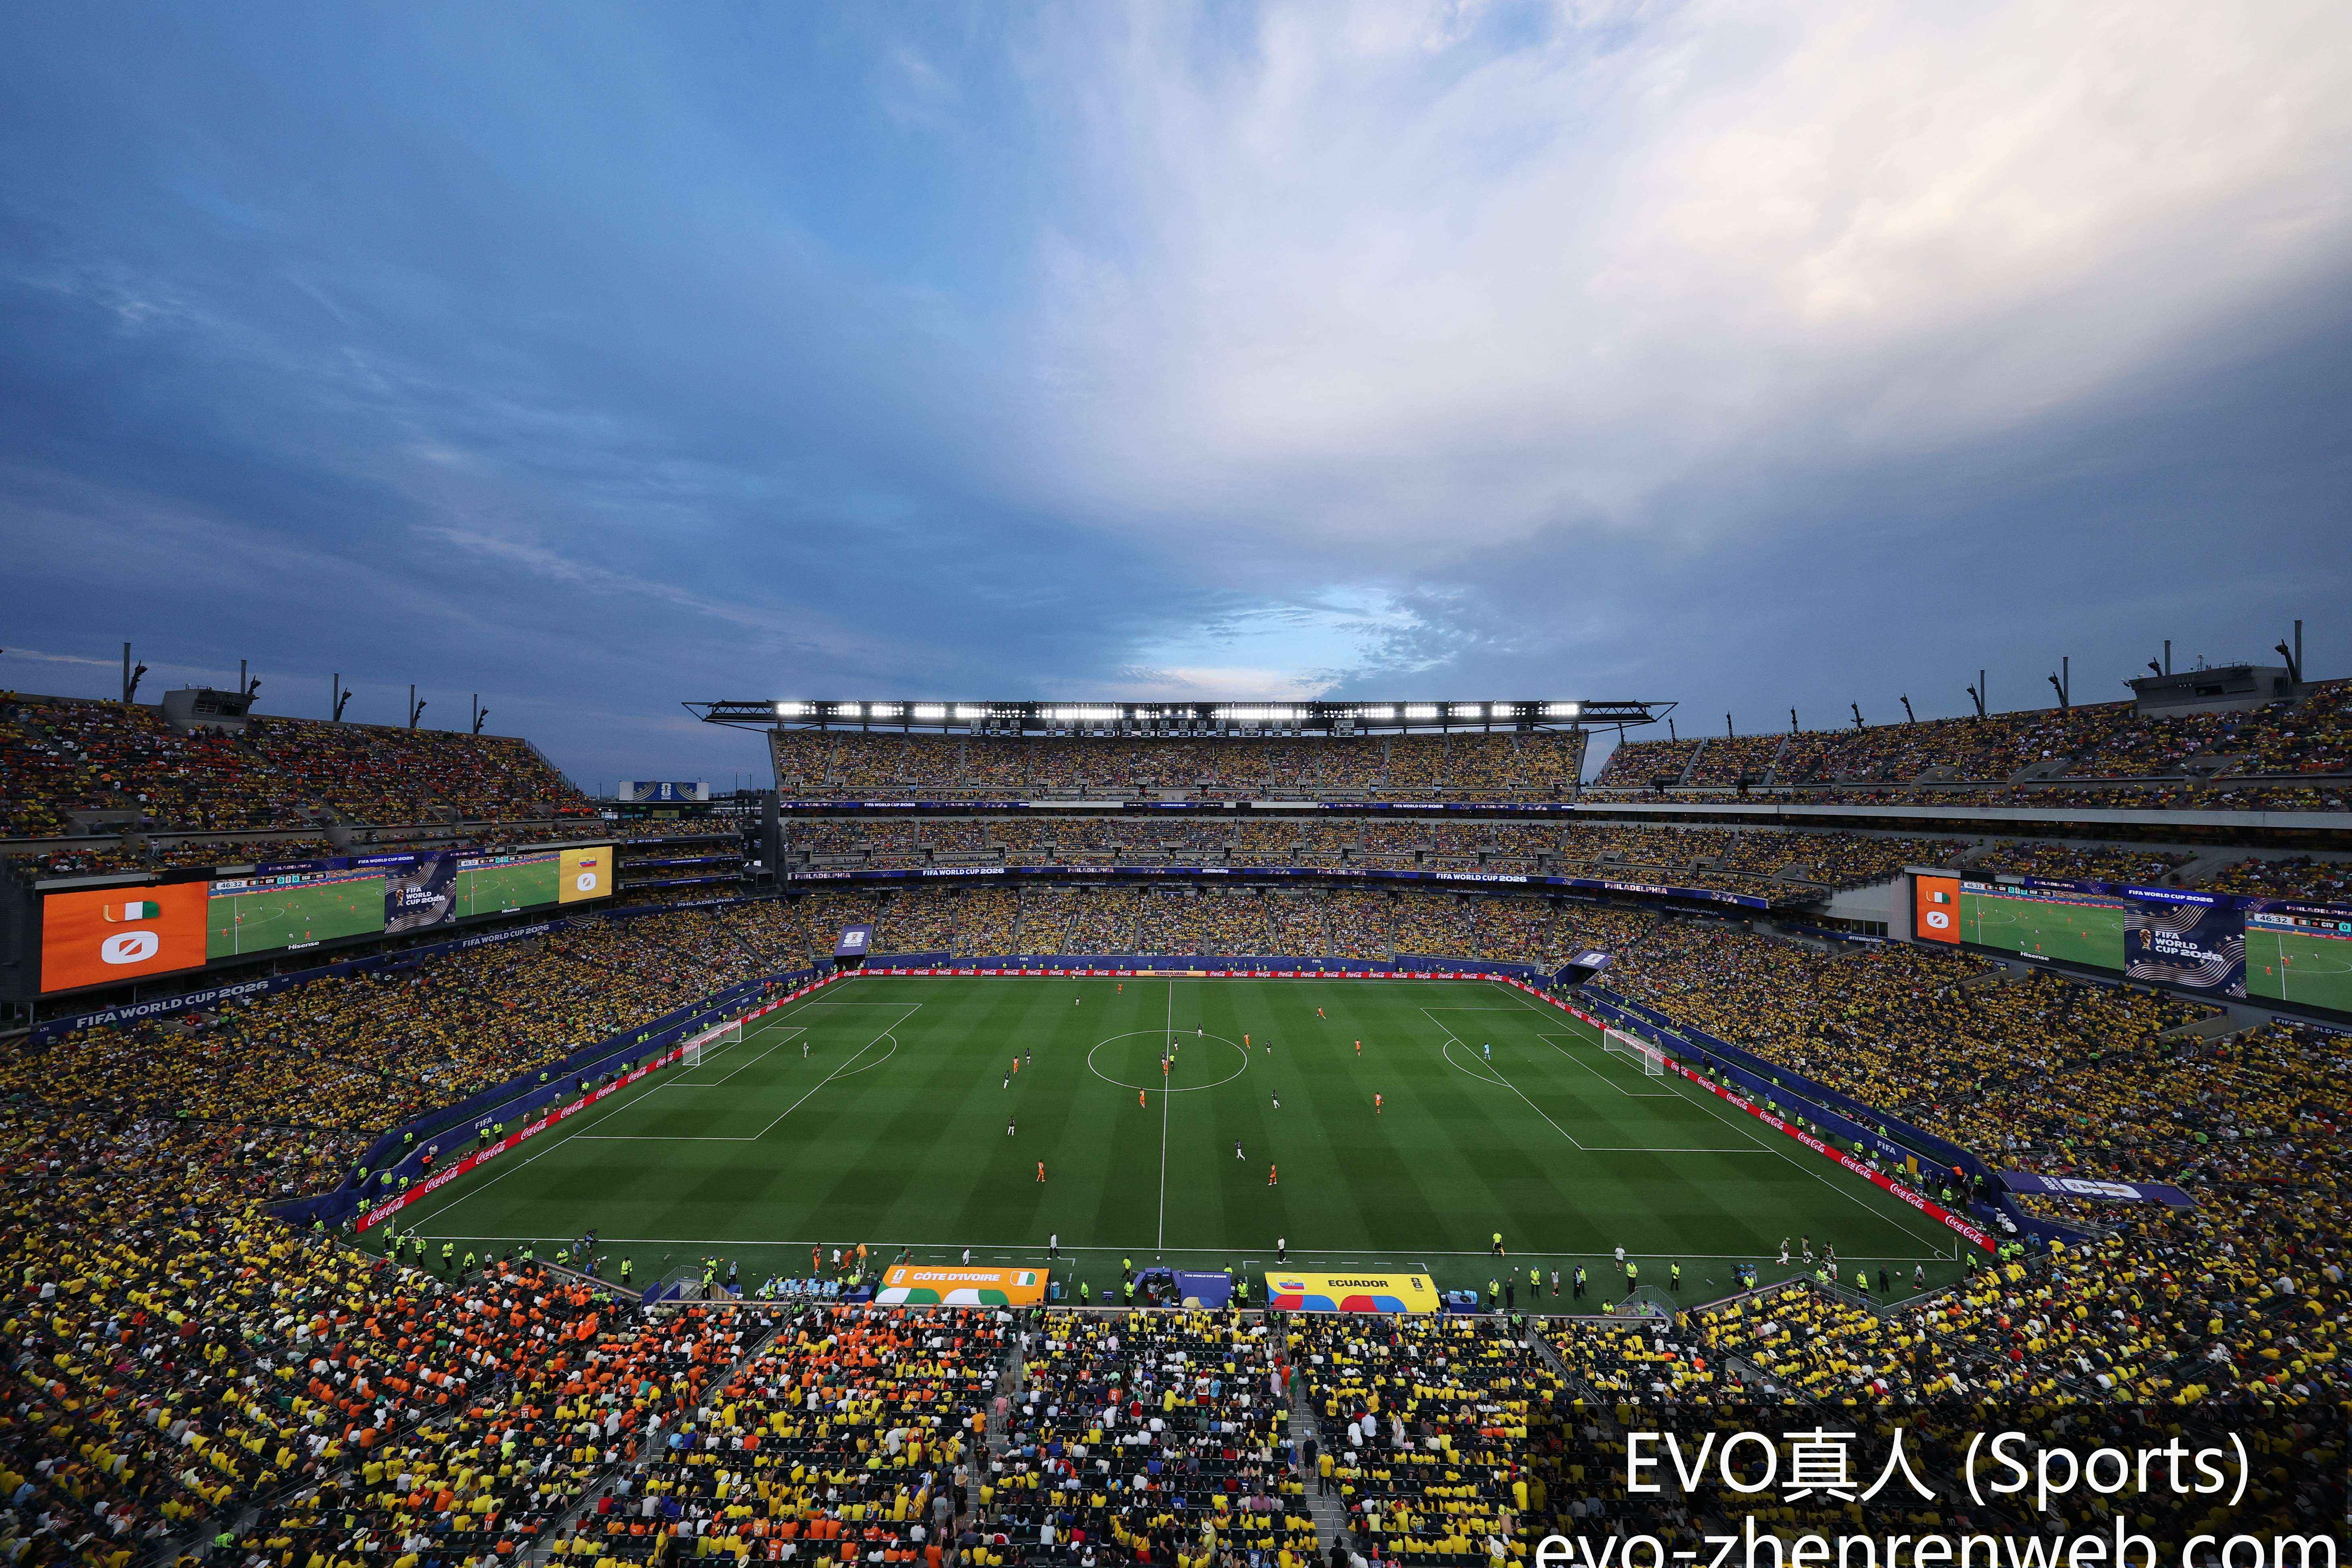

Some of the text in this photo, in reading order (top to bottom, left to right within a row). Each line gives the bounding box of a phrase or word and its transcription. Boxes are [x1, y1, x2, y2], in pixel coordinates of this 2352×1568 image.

[1604, 882, 1668, 894] PHILADELPHIA
[2034, 880, 2074, 888] PHILADELPHIA
[406, 891, 431, 899] WORLD
[421, 895, 445, 904] 2026
[677, 897, 734, 907] PHILADELPHIA
[1665, 906, 1719, 915] PHILADELPHIA
[2287, 905, 2352, 916] PHILADELPHIA
[2260, 915, 2287, 924] 46:32
[463, 939, 480, 947] FIFA
[482, 933, 509, 943] WORLD
[510, 929, 525, 937] CUP
[525, 924, 550, 935] 2026
[2155, 931, 2180, 941] FIFA
[288, 941, 320, 950] Hisense
[2155, 938, 2198, 950] WORLD
[2020, 951, 2050, 961] Hisense
[2155, 945, 2223, 962] CUP 2026
[77, 981, 269, 1028] FIFA WORLD CUP 2026
[628, 1066, 648, 1083] Coca-Cola
[596, 1081, 618, 1100] Coca-Cola
[1697, 1076, 1717, 1093] Coca-Cola
[561, 1098, 585, 1119] Coca-Cola
[1726, 1092, 1748, 1110] Coca-Cola
[475, 1117, 493, 1129] FIFA
[521, 1117, 548, 1140] Coca-Cola
[1759, 1111, 1784, 1131] Coca-Cola
[1797, 1132, 1825, 1154] Coca-Cola
[1877, 1140, 1896, 1156] FIFA
[476, 1140, 507, 1164] Coca-Cola
[1841, 1156, 1872, 1180] Coca-Cola
[425, 1166, 460, 1193] Coca-Cola
[1890, 1183, 1925, 1209] Coca-Cola
[368, 1194, 407, 1226] Coca-Cola
[1945, 1215, 1983, 1246] Coca-Cola
[913, 1271, 1001, 1282] CÔTE D'IVOIRE
[1328, 1280, 1389, 1288] ECUADOR
[484, 1521, 492, 1529] 10
